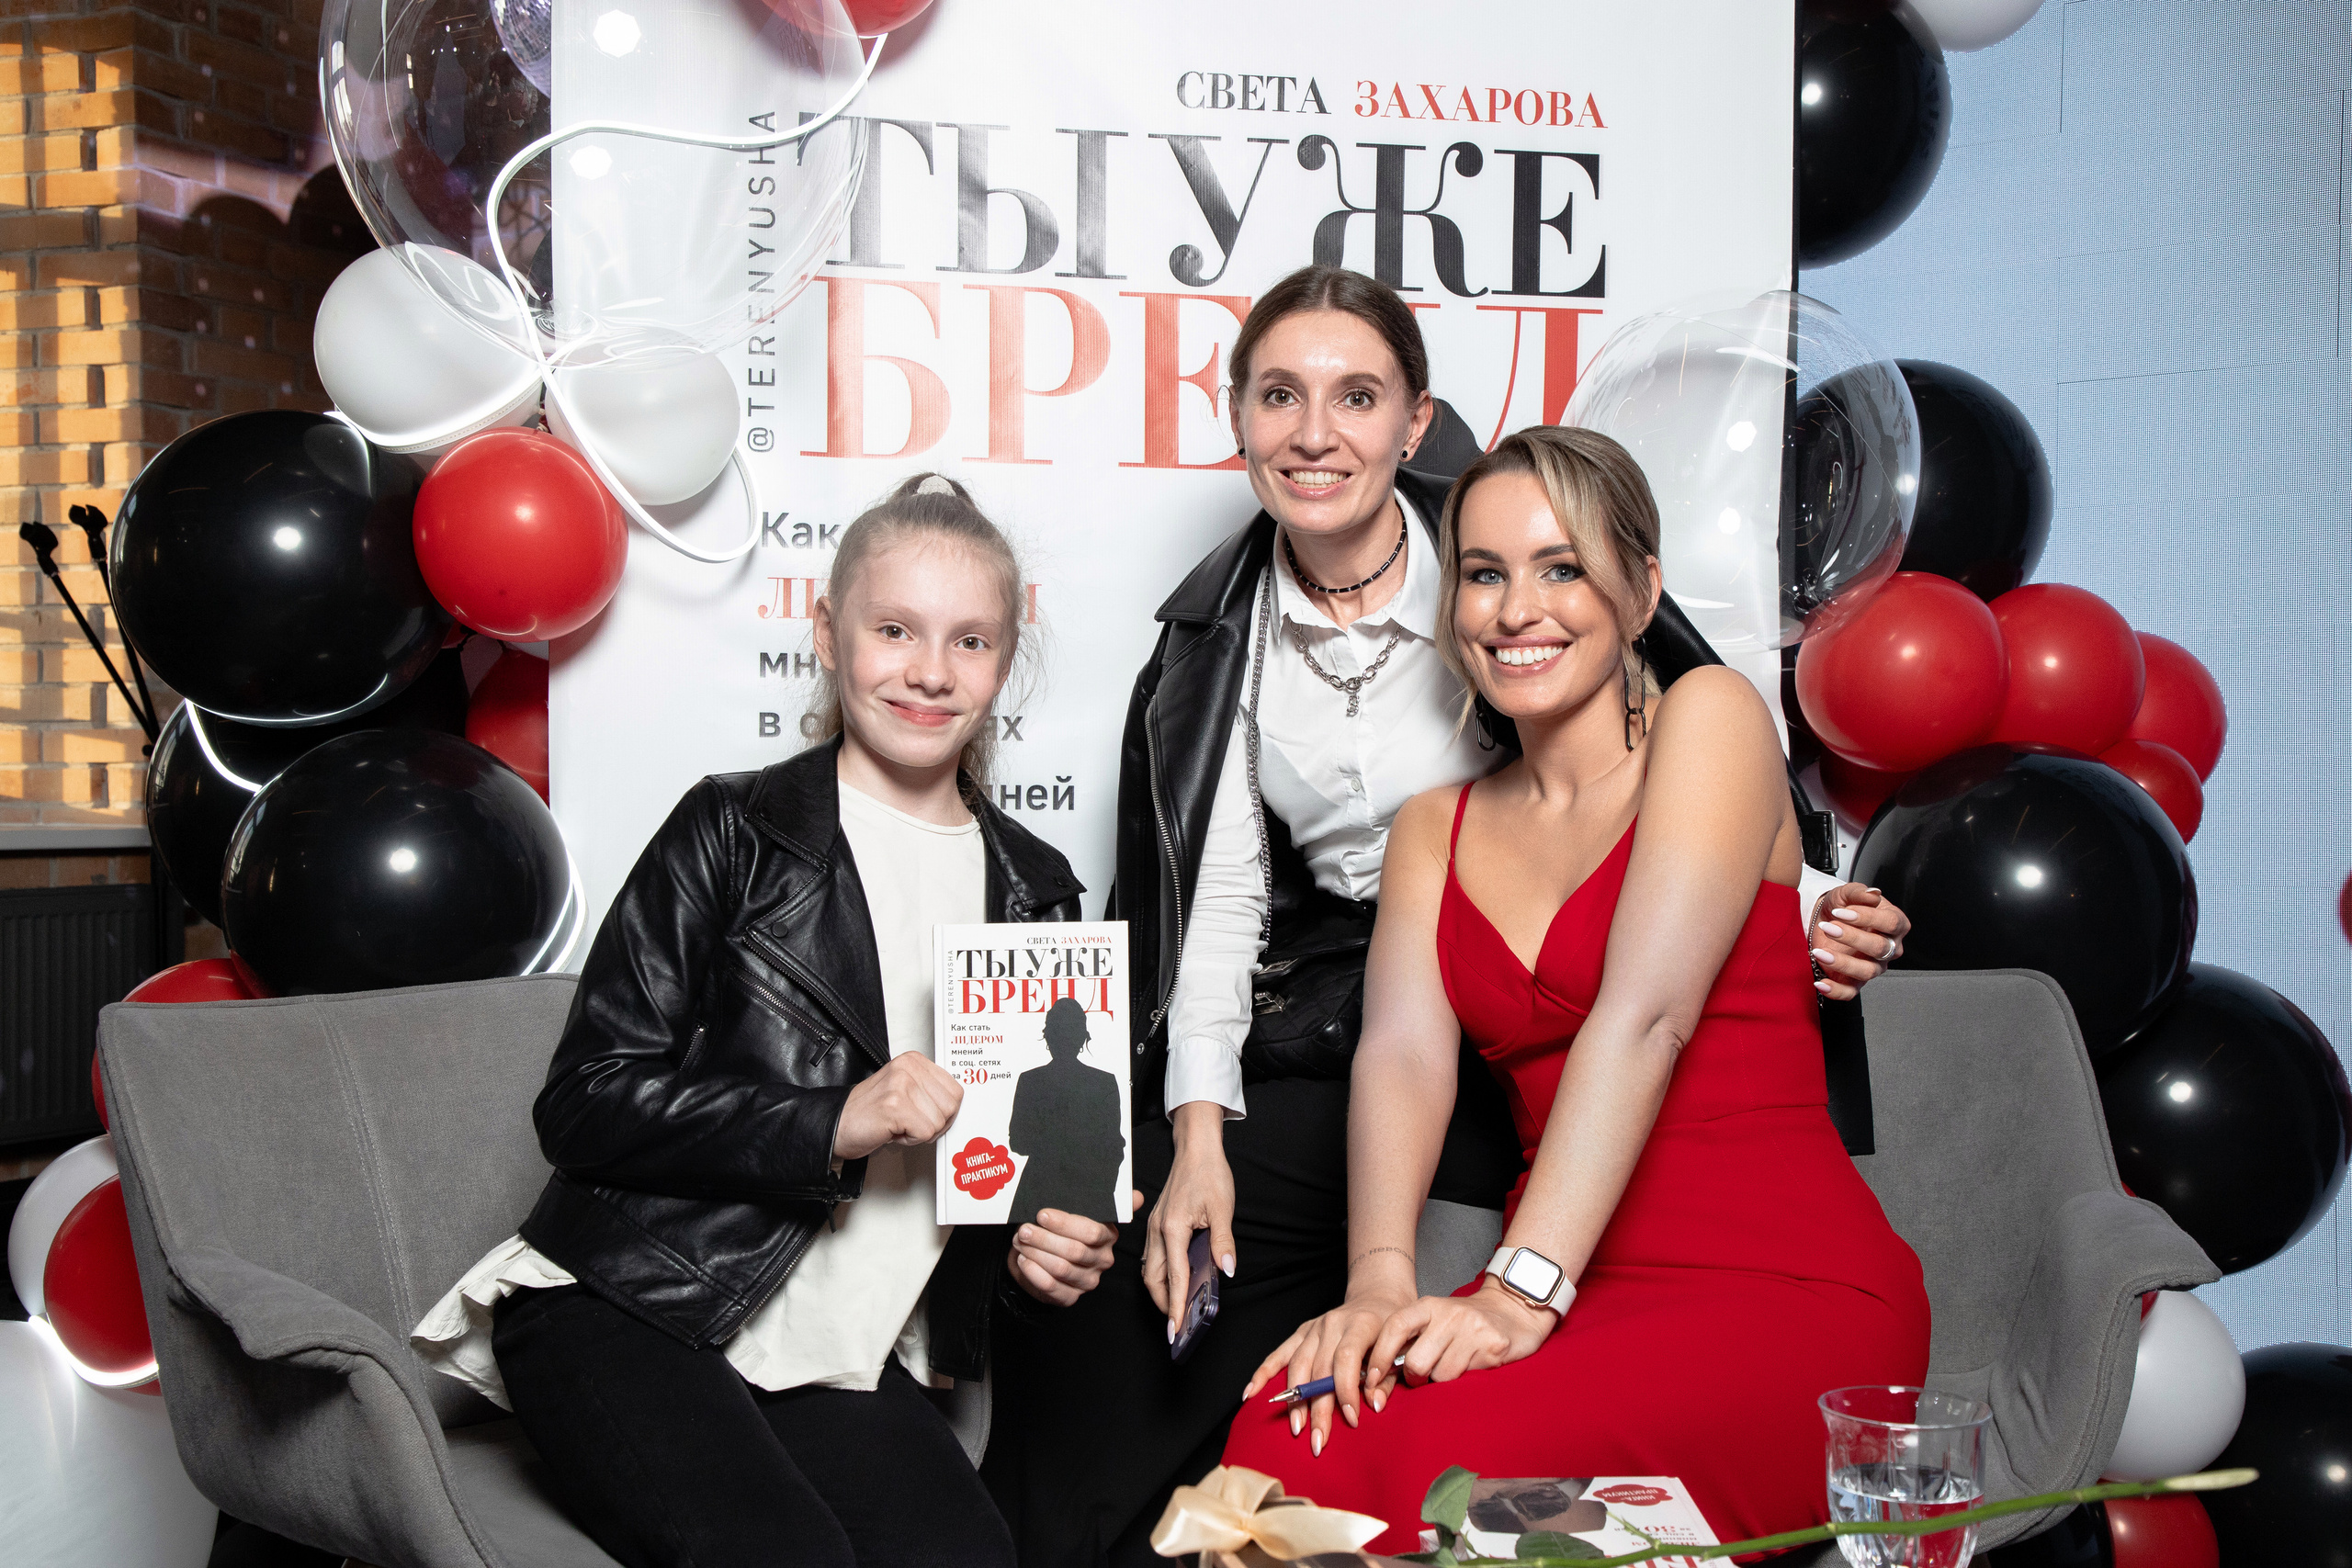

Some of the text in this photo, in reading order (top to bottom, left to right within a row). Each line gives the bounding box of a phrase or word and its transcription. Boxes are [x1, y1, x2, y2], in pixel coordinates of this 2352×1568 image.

[1177, 70, 1609, 129] СВЕТА ЗАХАРОВА
[746, 109, 776, 454] @TERENYUSHA
[761, 511, 842, 550] Как
[1026, 936, 1113, 945] СВЕТА ЗАХАРОВА
[951, 1023, 967, 1032] Как
[951, 1035, 1003, 1045] ЛИДЕРОМ
[951, 1047, 983, 1055] мнений
[963, 1067, 989, 1086] 30
[989, 1071, 1012, 1080] дней
[965, 1152, 996, 1168] КНИГА-
[960, 1163, 1009, 1185] ПРАКТИКУМ
